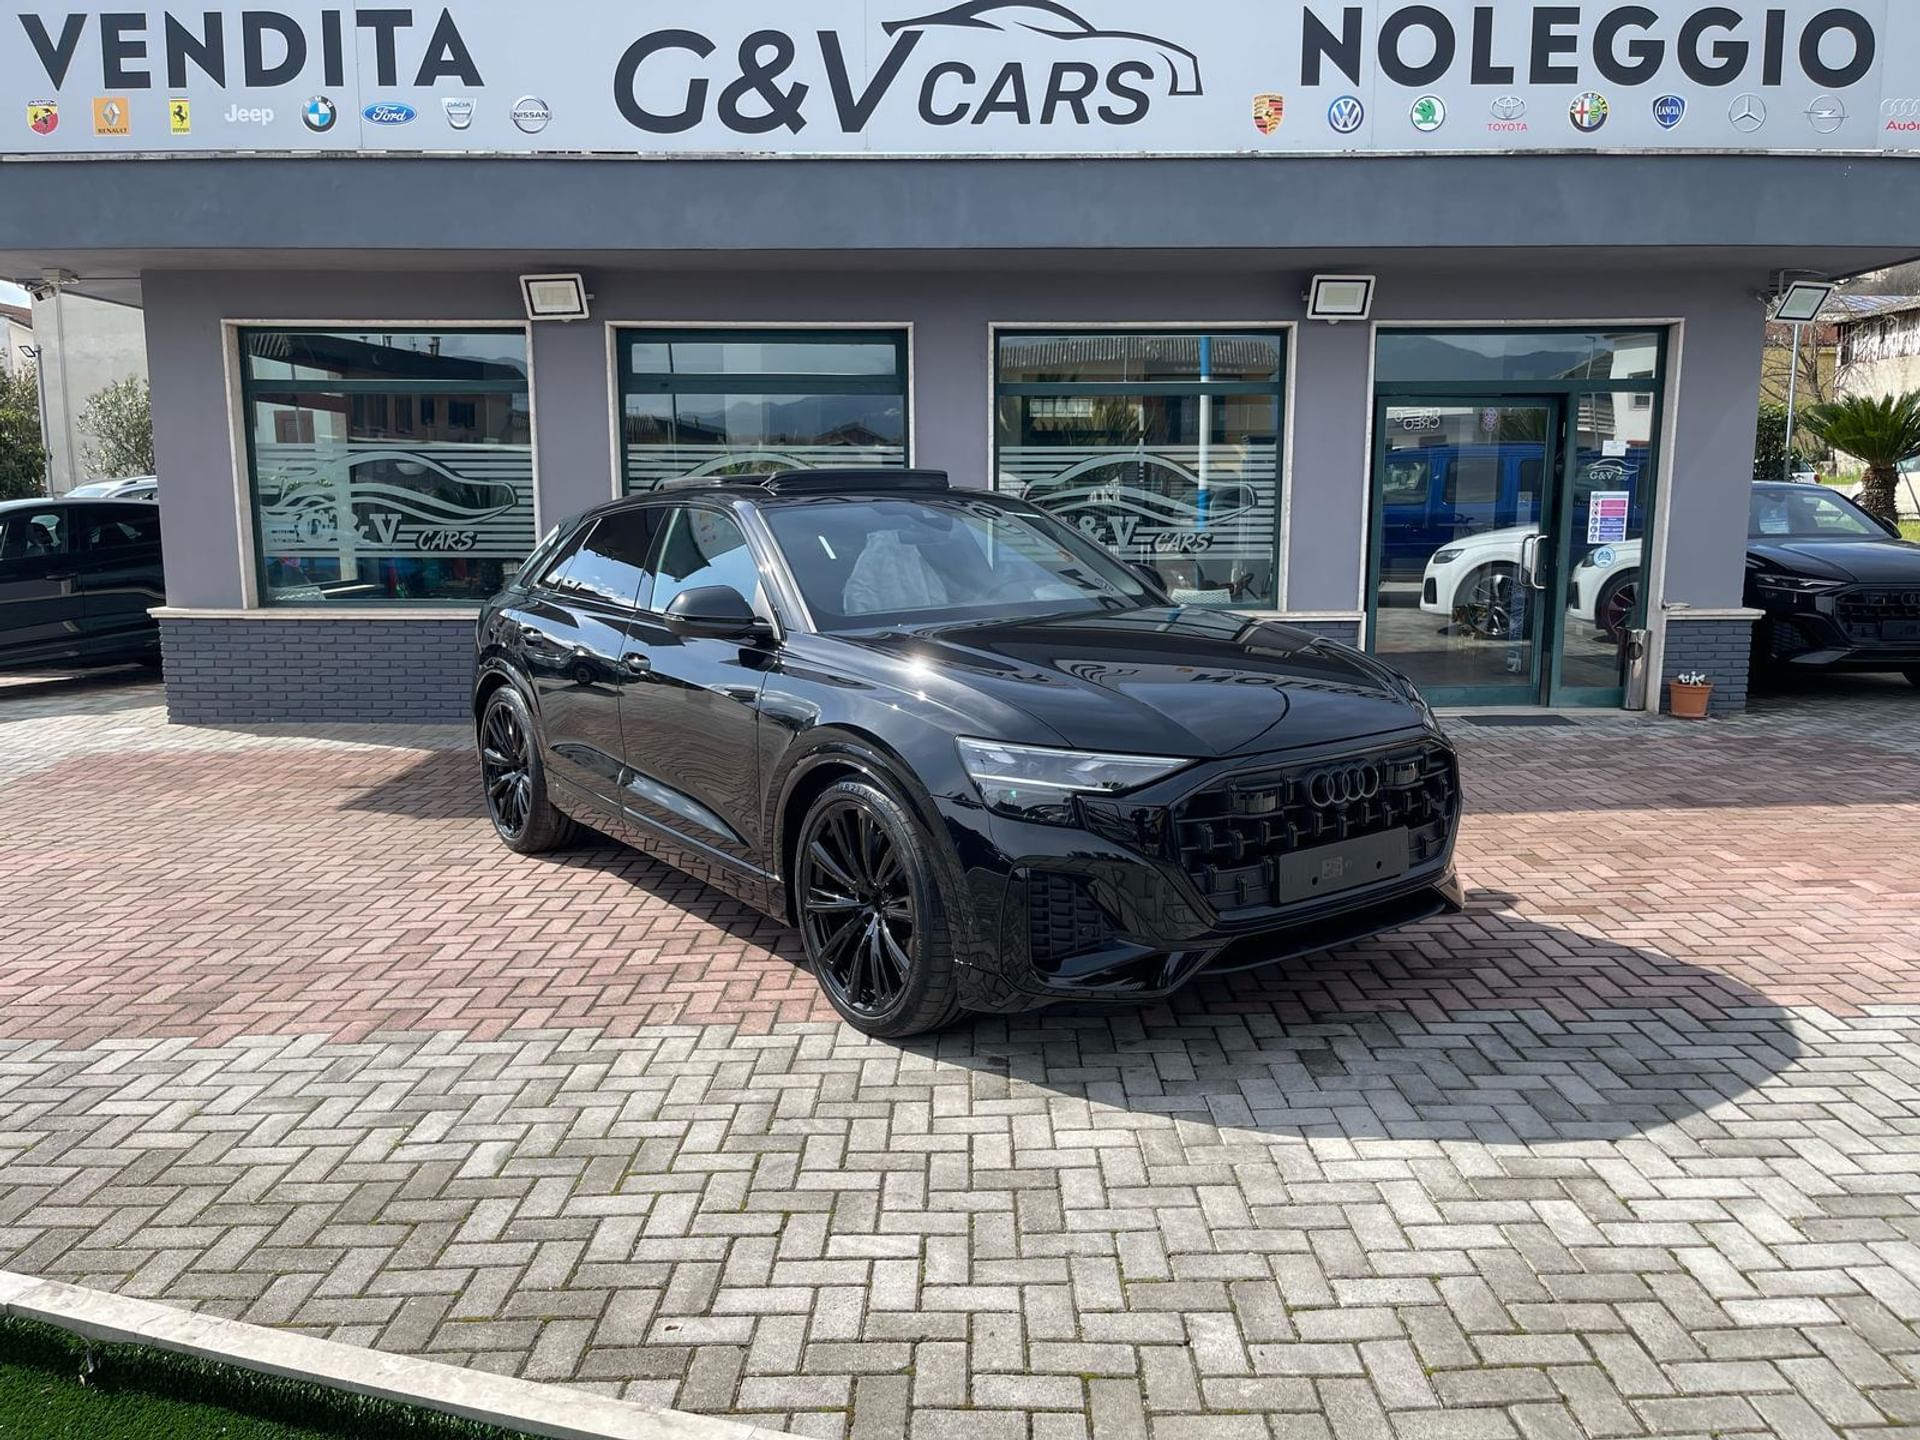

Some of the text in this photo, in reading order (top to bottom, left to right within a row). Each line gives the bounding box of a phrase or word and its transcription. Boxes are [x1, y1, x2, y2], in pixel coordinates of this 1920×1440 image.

[18, 8, 484, 91] VENDITA
[1301, 5, 1875, 88] NOLEGGIO
[614, 30, 1154, 134] G&V CARS
[225, 104, 274, 126] Jeep
[372, 104, 407, 122] Ford
[513, 111, 549, 119] NISSAN
[1657, 105, 1680, 115] LANCIA
[1487, 123, 1528, 131] TOYOTA
[417, 530, 475, 551] CARS
[1154, 532, 1212, 552] CARS
